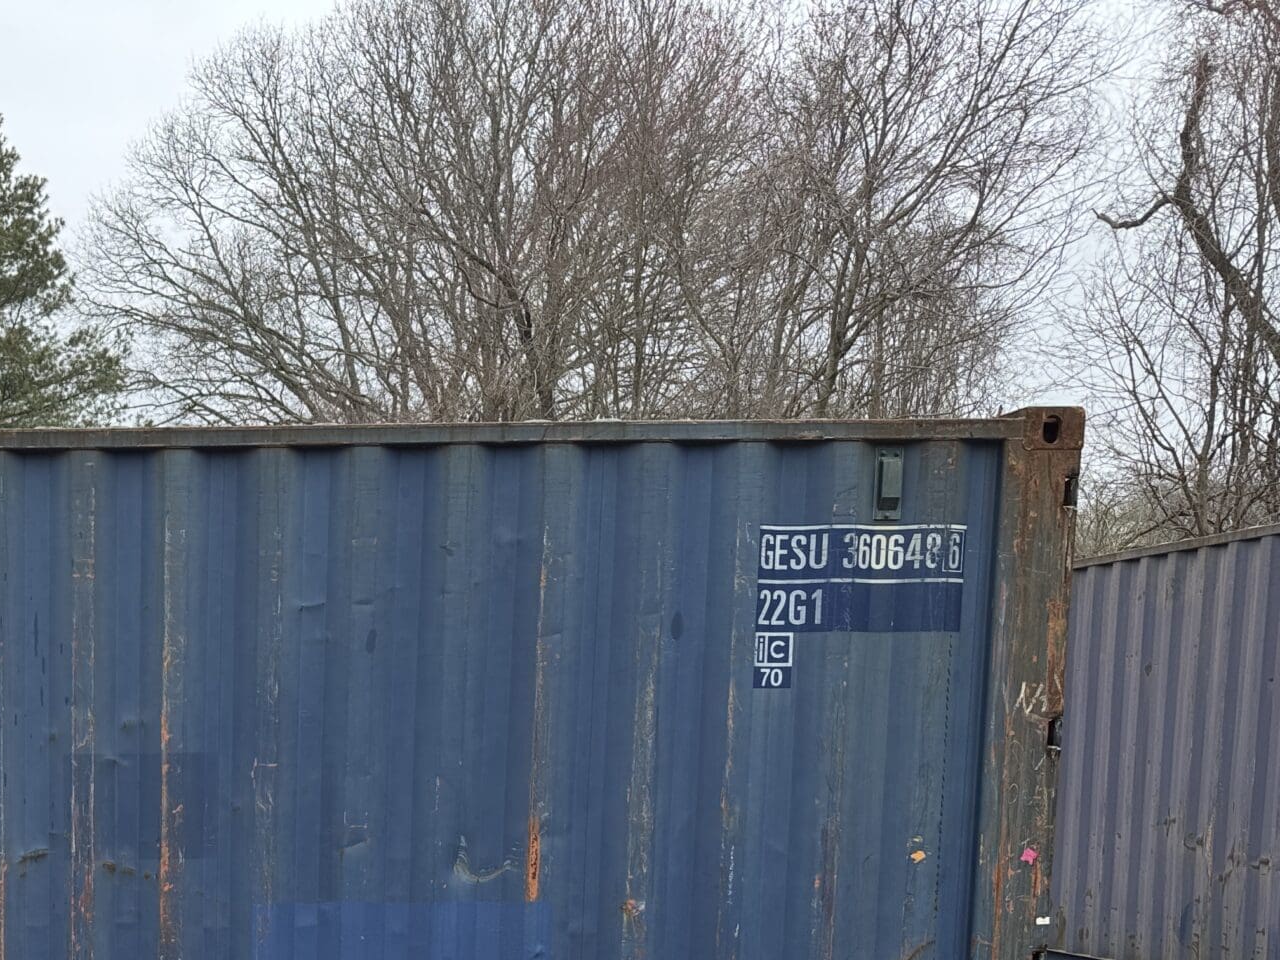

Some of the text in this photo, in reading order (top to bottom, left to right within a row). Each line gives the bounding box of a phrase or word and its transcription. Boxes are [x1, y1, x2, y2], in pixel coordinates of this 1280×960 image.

[760, 533, 829, 570] GESU
[757, 588, 823, 626] 22G1
[760, 668, 783, 687] 70
